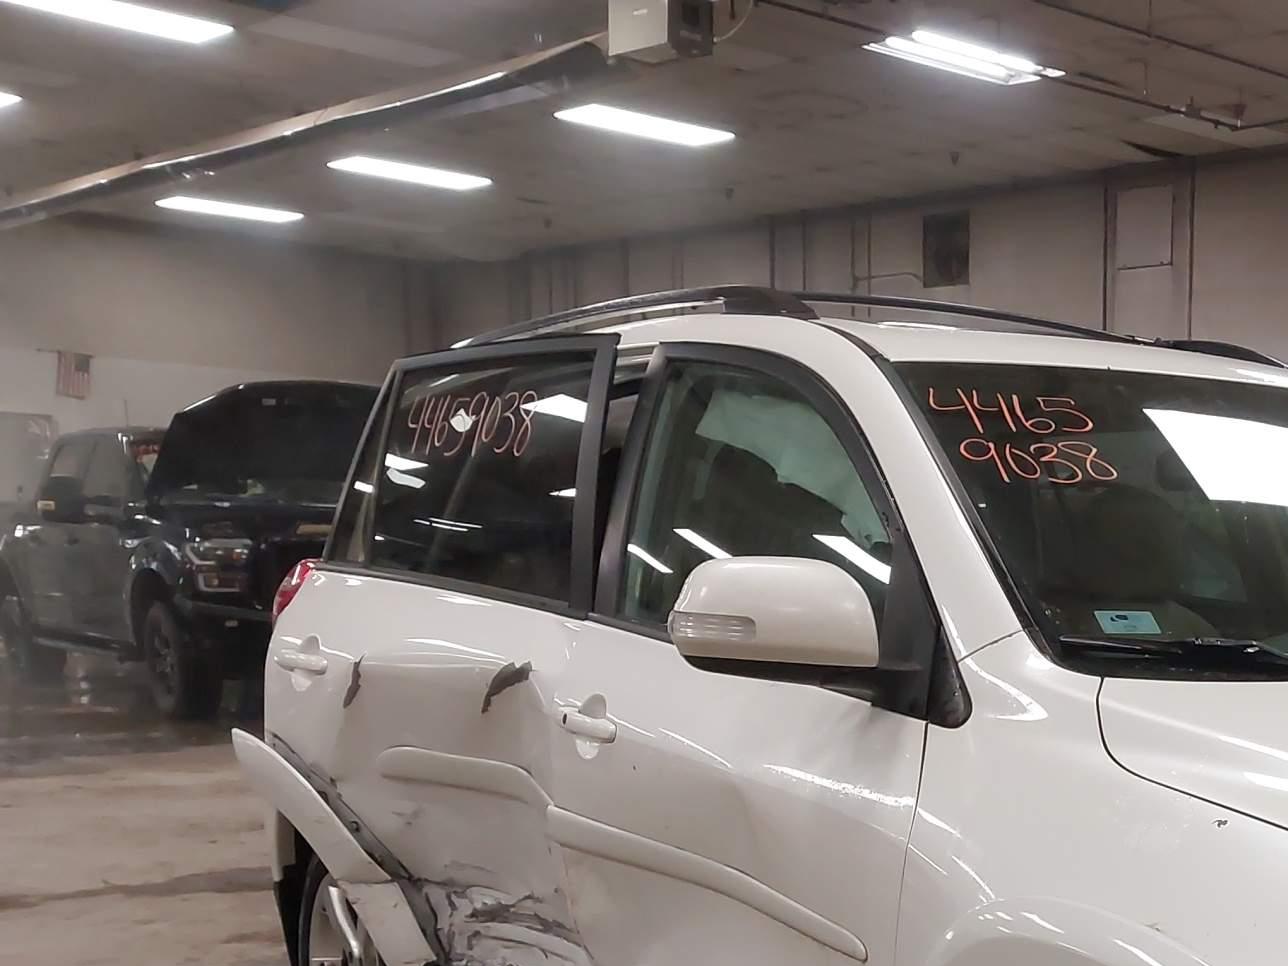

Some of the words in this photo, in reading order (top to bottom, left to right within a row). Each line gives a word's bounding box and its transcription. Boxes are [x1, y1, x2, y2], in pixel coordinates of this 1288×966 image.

[408, 391, 537, 457] 44659038
[929, 388, 1093, 433] 4465
[960, 438, 1118, 483] 9038
